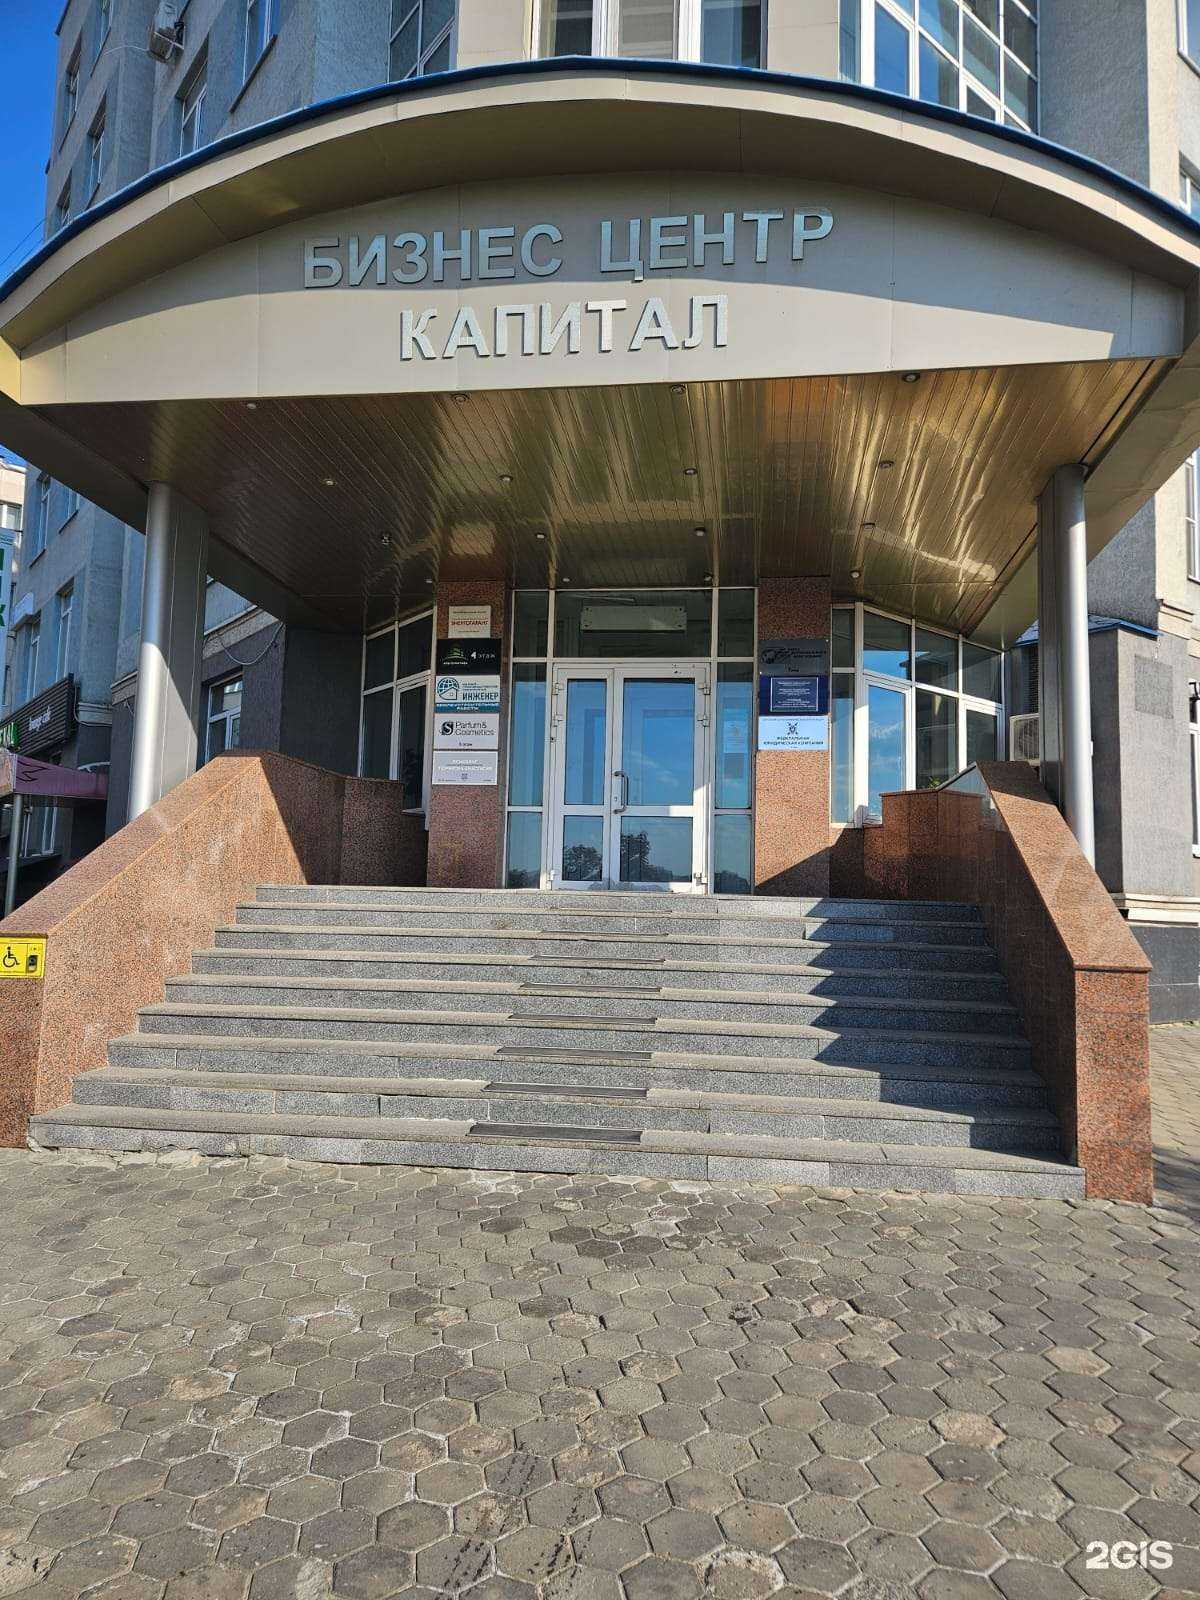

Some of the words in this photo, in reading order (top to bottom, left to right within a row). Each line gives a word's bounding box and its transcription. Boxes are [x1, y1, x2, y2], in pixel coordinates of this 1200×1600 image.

[303, 222, 563, 289] БИЗНЕС
[600, 207, 835, 283] ЦЕНТР
[400, 294, 730, 361] КАПИТАЛ
[470, 651, 477, 660] 4
[462, 692, 499, 701] ИНЖЕНЕР
